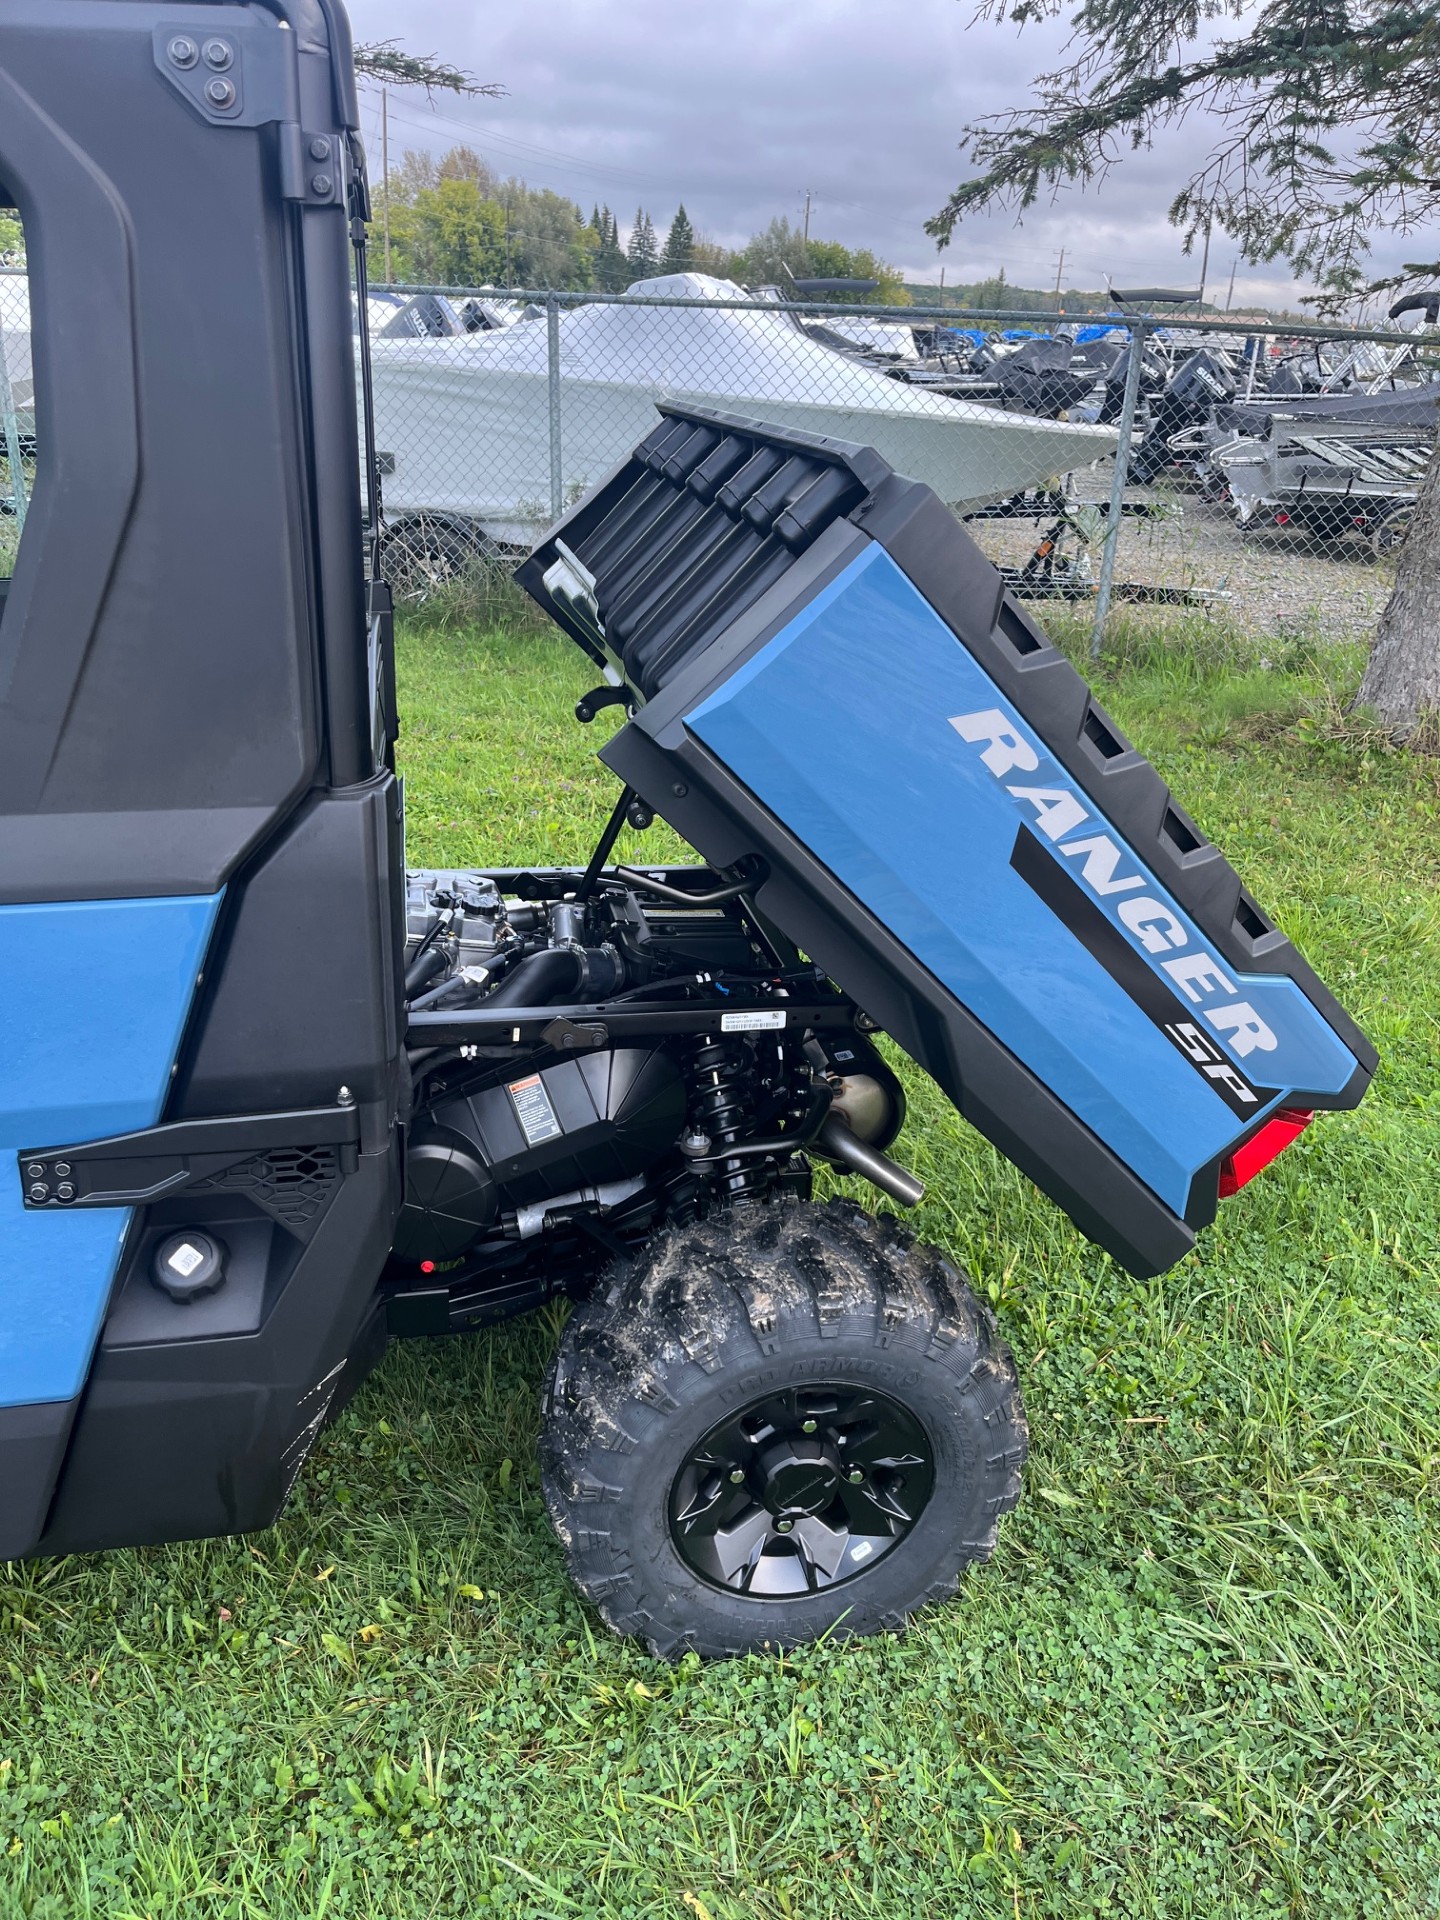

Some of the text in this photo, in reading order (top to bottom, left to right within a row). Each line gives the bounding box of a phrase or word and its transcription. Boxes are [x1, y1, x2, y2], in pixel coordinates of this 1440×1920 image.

[1196, 366, 1227, 397] SUZUKI
[947, 708, 1278, 1058] RANGER
[1164, 1022, 1258, 1102] SP
[718, 1357, 897, 1403] PRO ARMOR
